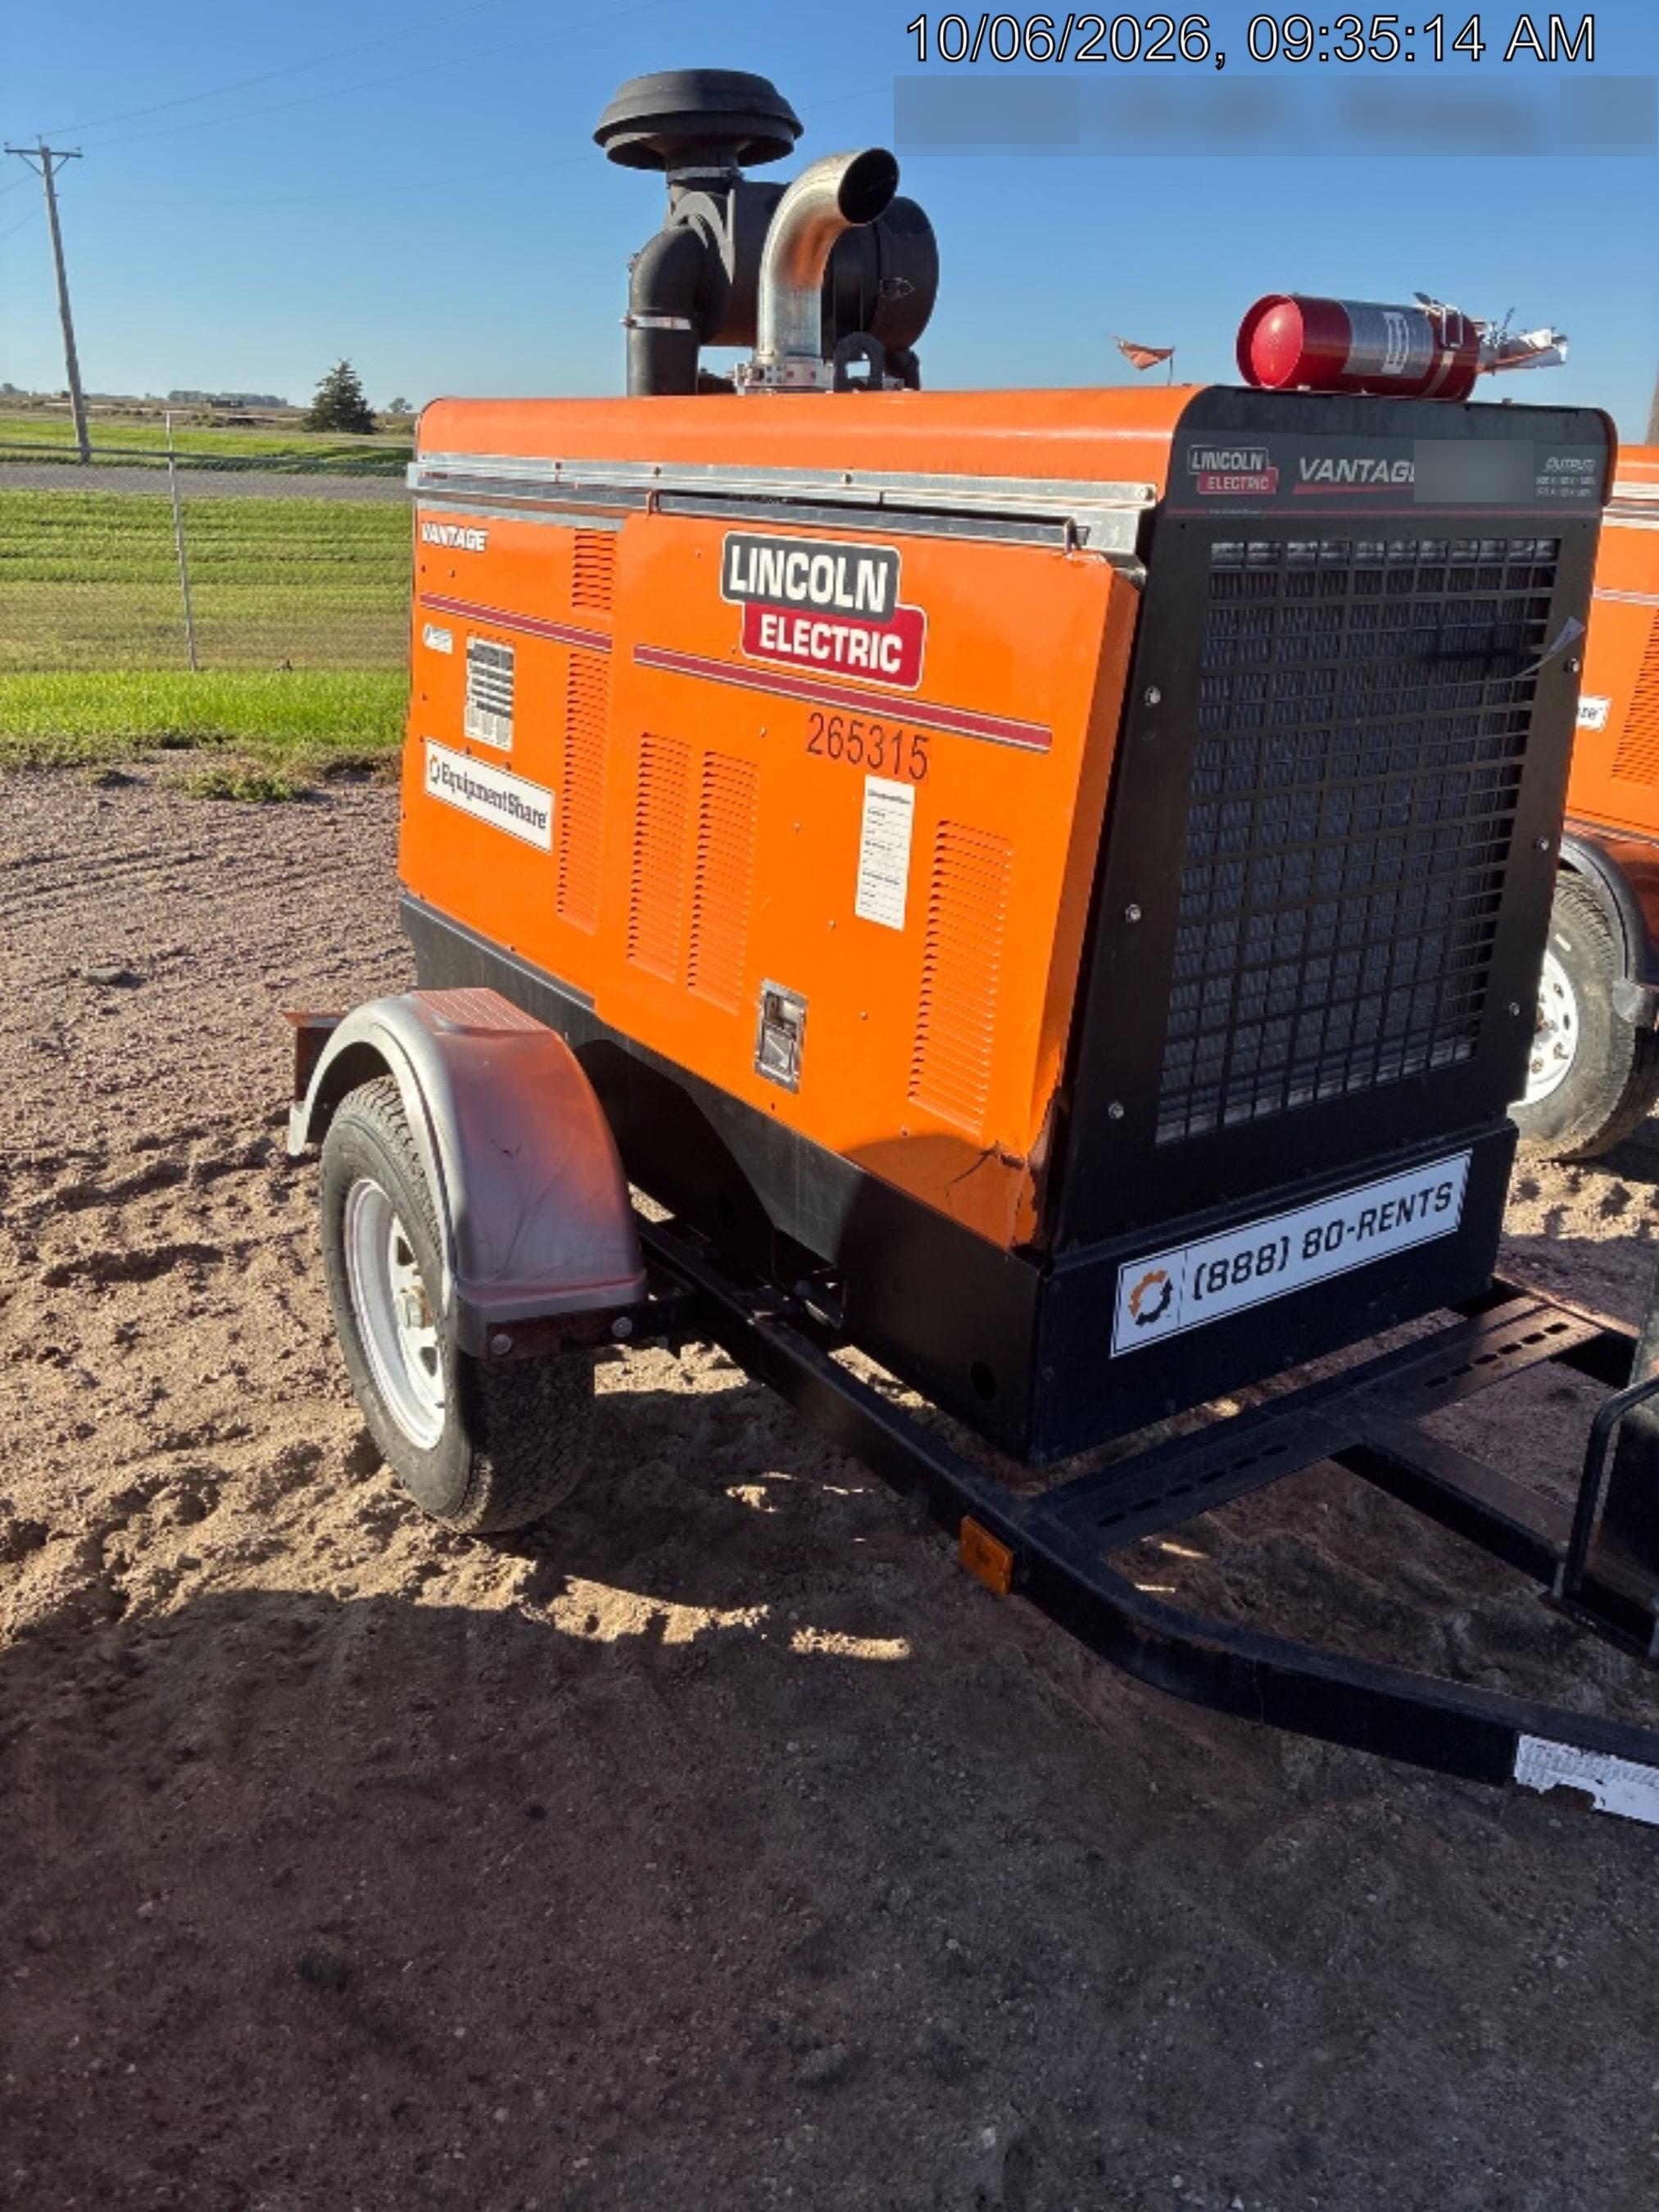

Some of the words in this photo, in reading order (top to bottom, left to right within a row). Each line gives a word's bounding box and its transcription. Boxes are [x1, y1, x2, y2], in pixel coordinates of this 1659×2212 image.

[1191, 451, 1264, 471] LINCOLN
[1207, 475, 1270, 491] ELECTRIC
[422, 521, 489, 552] VANTAGE
[728, 545, 888, 613] LINCOLN
[759, 614, 903, 673] ELECTRIC
[805, 711, 931, 781] 265315
[441, 762, 548, 830] EquipmentShare
[1193, 1236, 1290, 1301] (888)
[1302, 1181, 1454, 1260] 80-RENTS
